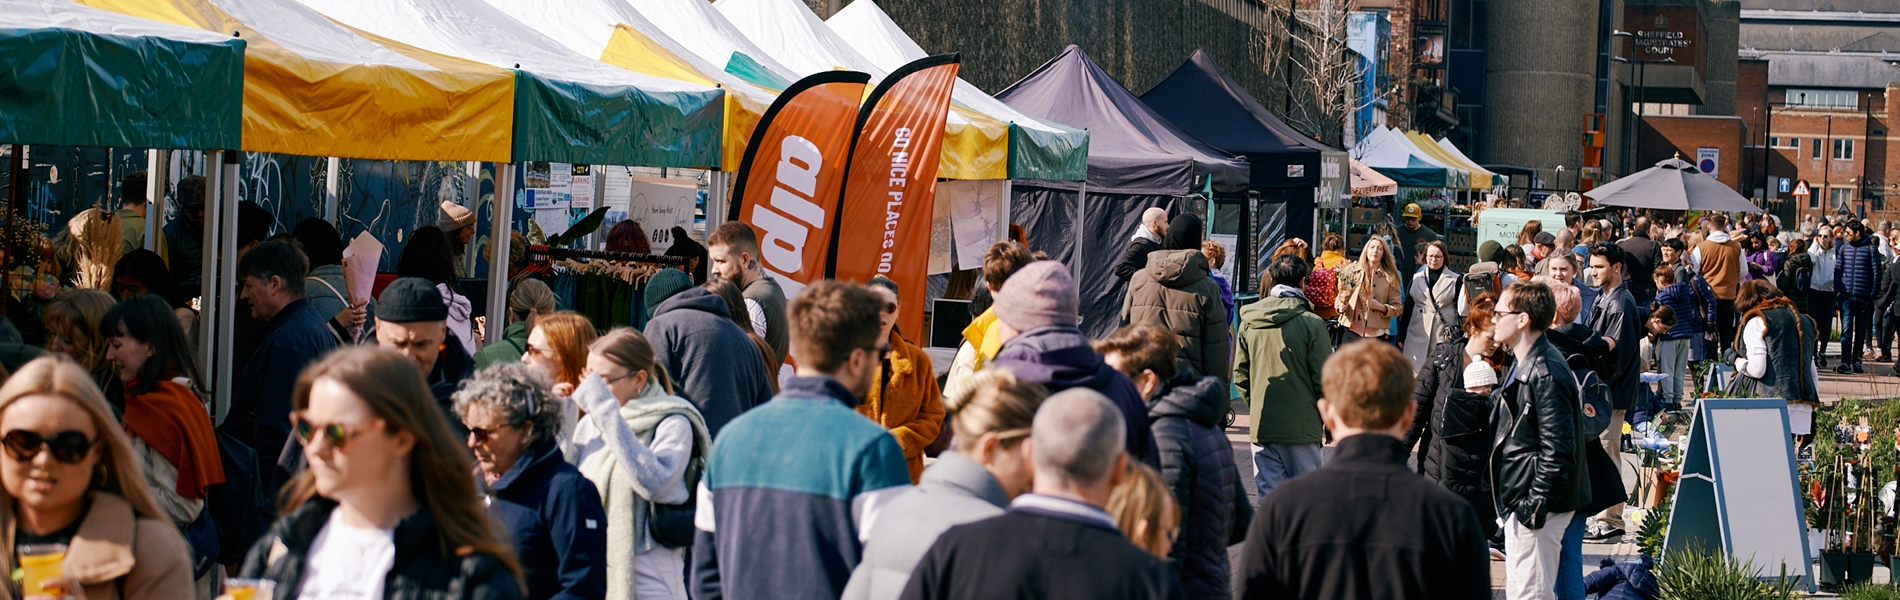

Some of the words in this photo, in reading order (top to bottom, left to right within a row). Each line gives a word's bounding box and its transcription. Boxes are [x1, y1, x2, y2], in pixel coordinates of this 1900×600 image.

[1637, 30, 1684, 39] SHEFFIELD
[1645, 46, 1675, 54] COURT
[894, 127, 911, 148] GO
[888, 151, 909, 188] NICE
[1354, 185, 1390, 195] FEVER-TREE
[882, 191, 904, 249] PLACES
[1499, 231, 1518, 239] MOT
[877, 252, 893, 273] DO
